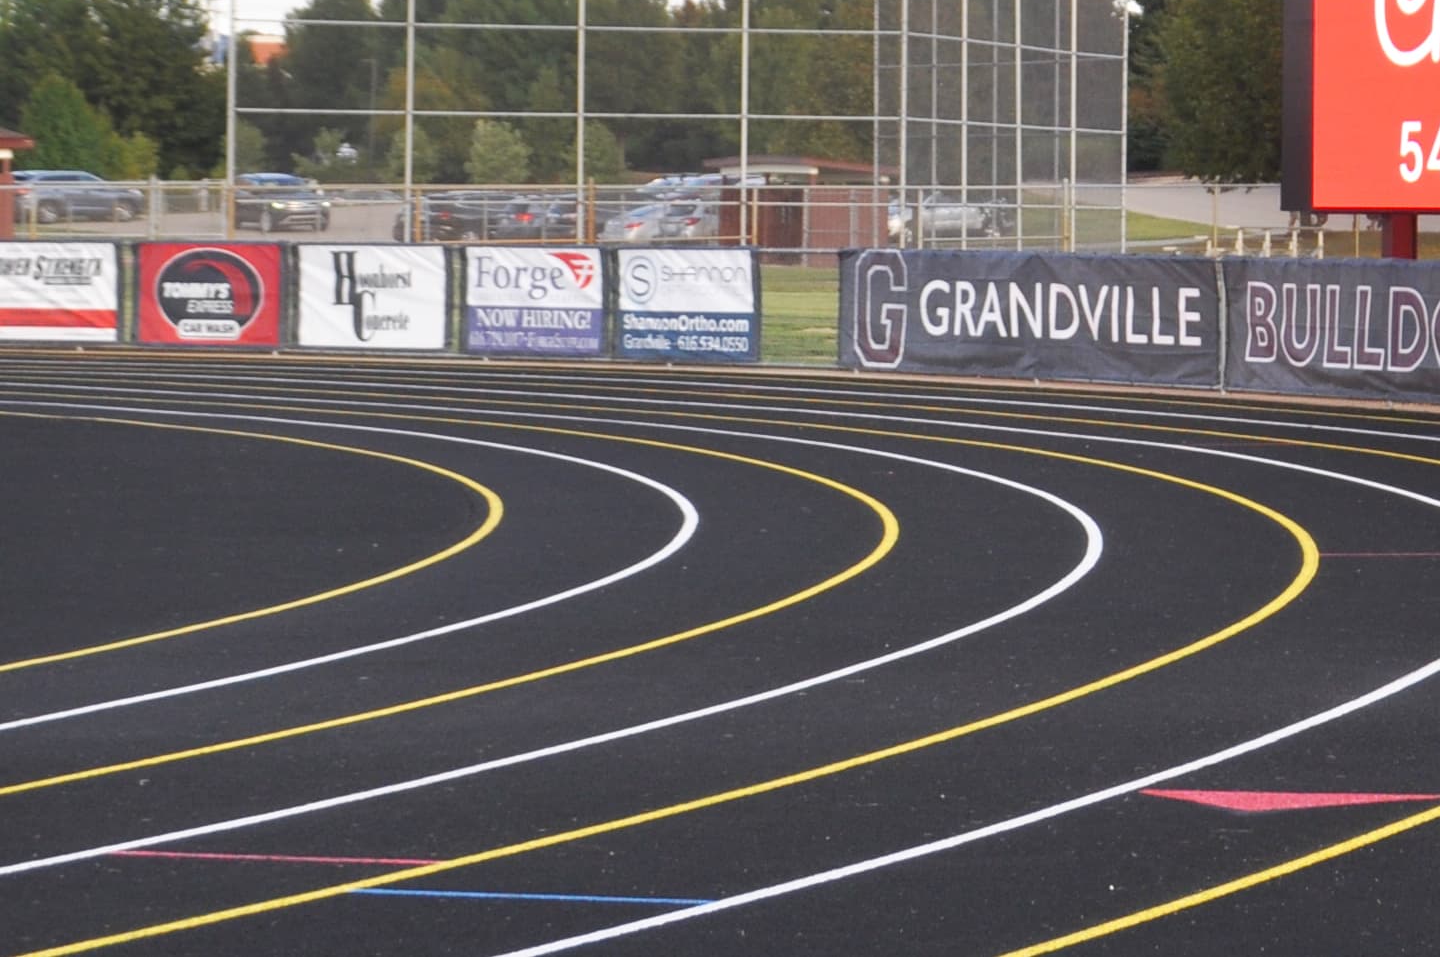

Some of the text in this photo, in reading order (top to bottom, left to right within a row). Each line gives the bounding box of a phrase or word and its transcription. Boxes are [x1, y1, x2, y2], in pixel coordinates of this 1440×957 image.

[475, 256, 565, 300] Forge
[475, 308, 592, 330] NOW HIRING!
[623, 313, 750, 332] ShannonOrtho.com
[854, 249, 907, 368] G
[920, 280, 1201, 346] GRANDVILLE
[183, 323, 235, 334] CAR WASH
